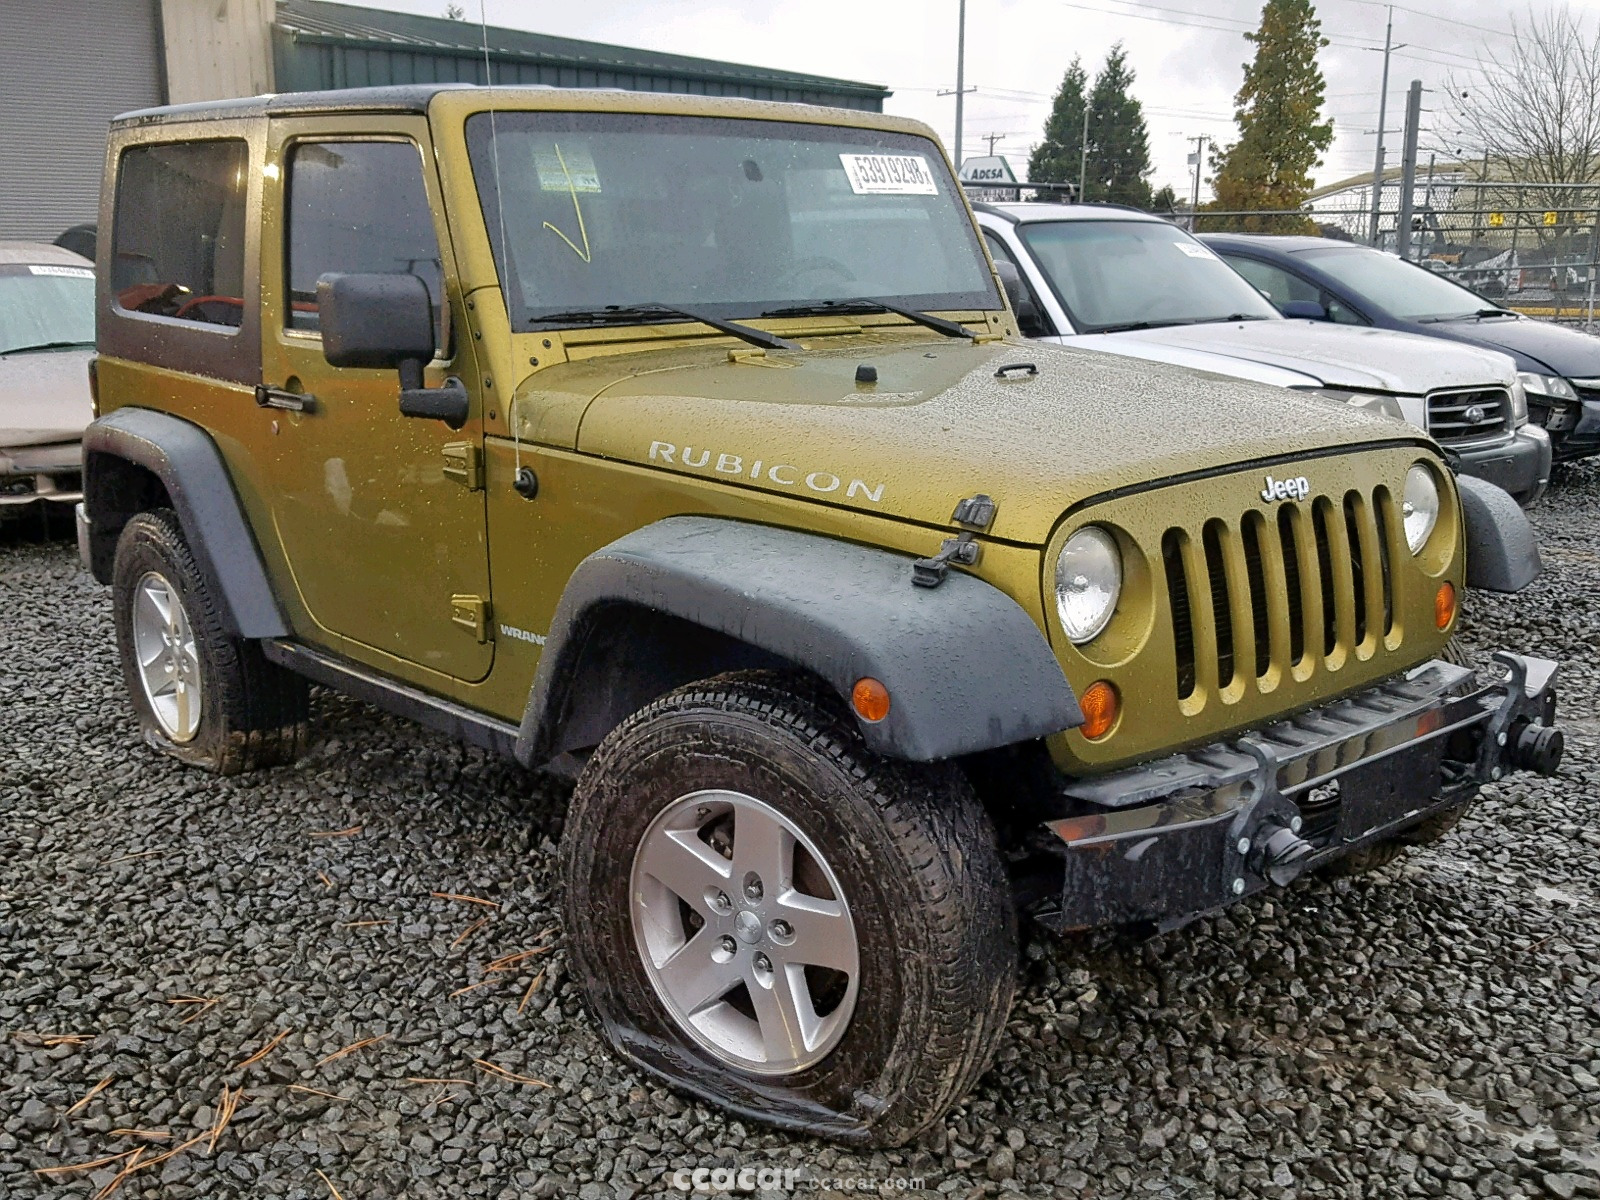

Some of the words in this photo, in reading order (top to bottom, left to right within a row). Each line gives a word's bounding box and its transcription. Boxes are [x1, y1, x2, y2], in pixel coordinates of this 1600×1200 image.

[854, 156, 924, 184] 53919298
[649, 441, 884, 502] RUBICON
[1261, 475, 1309, 501] Jeep
